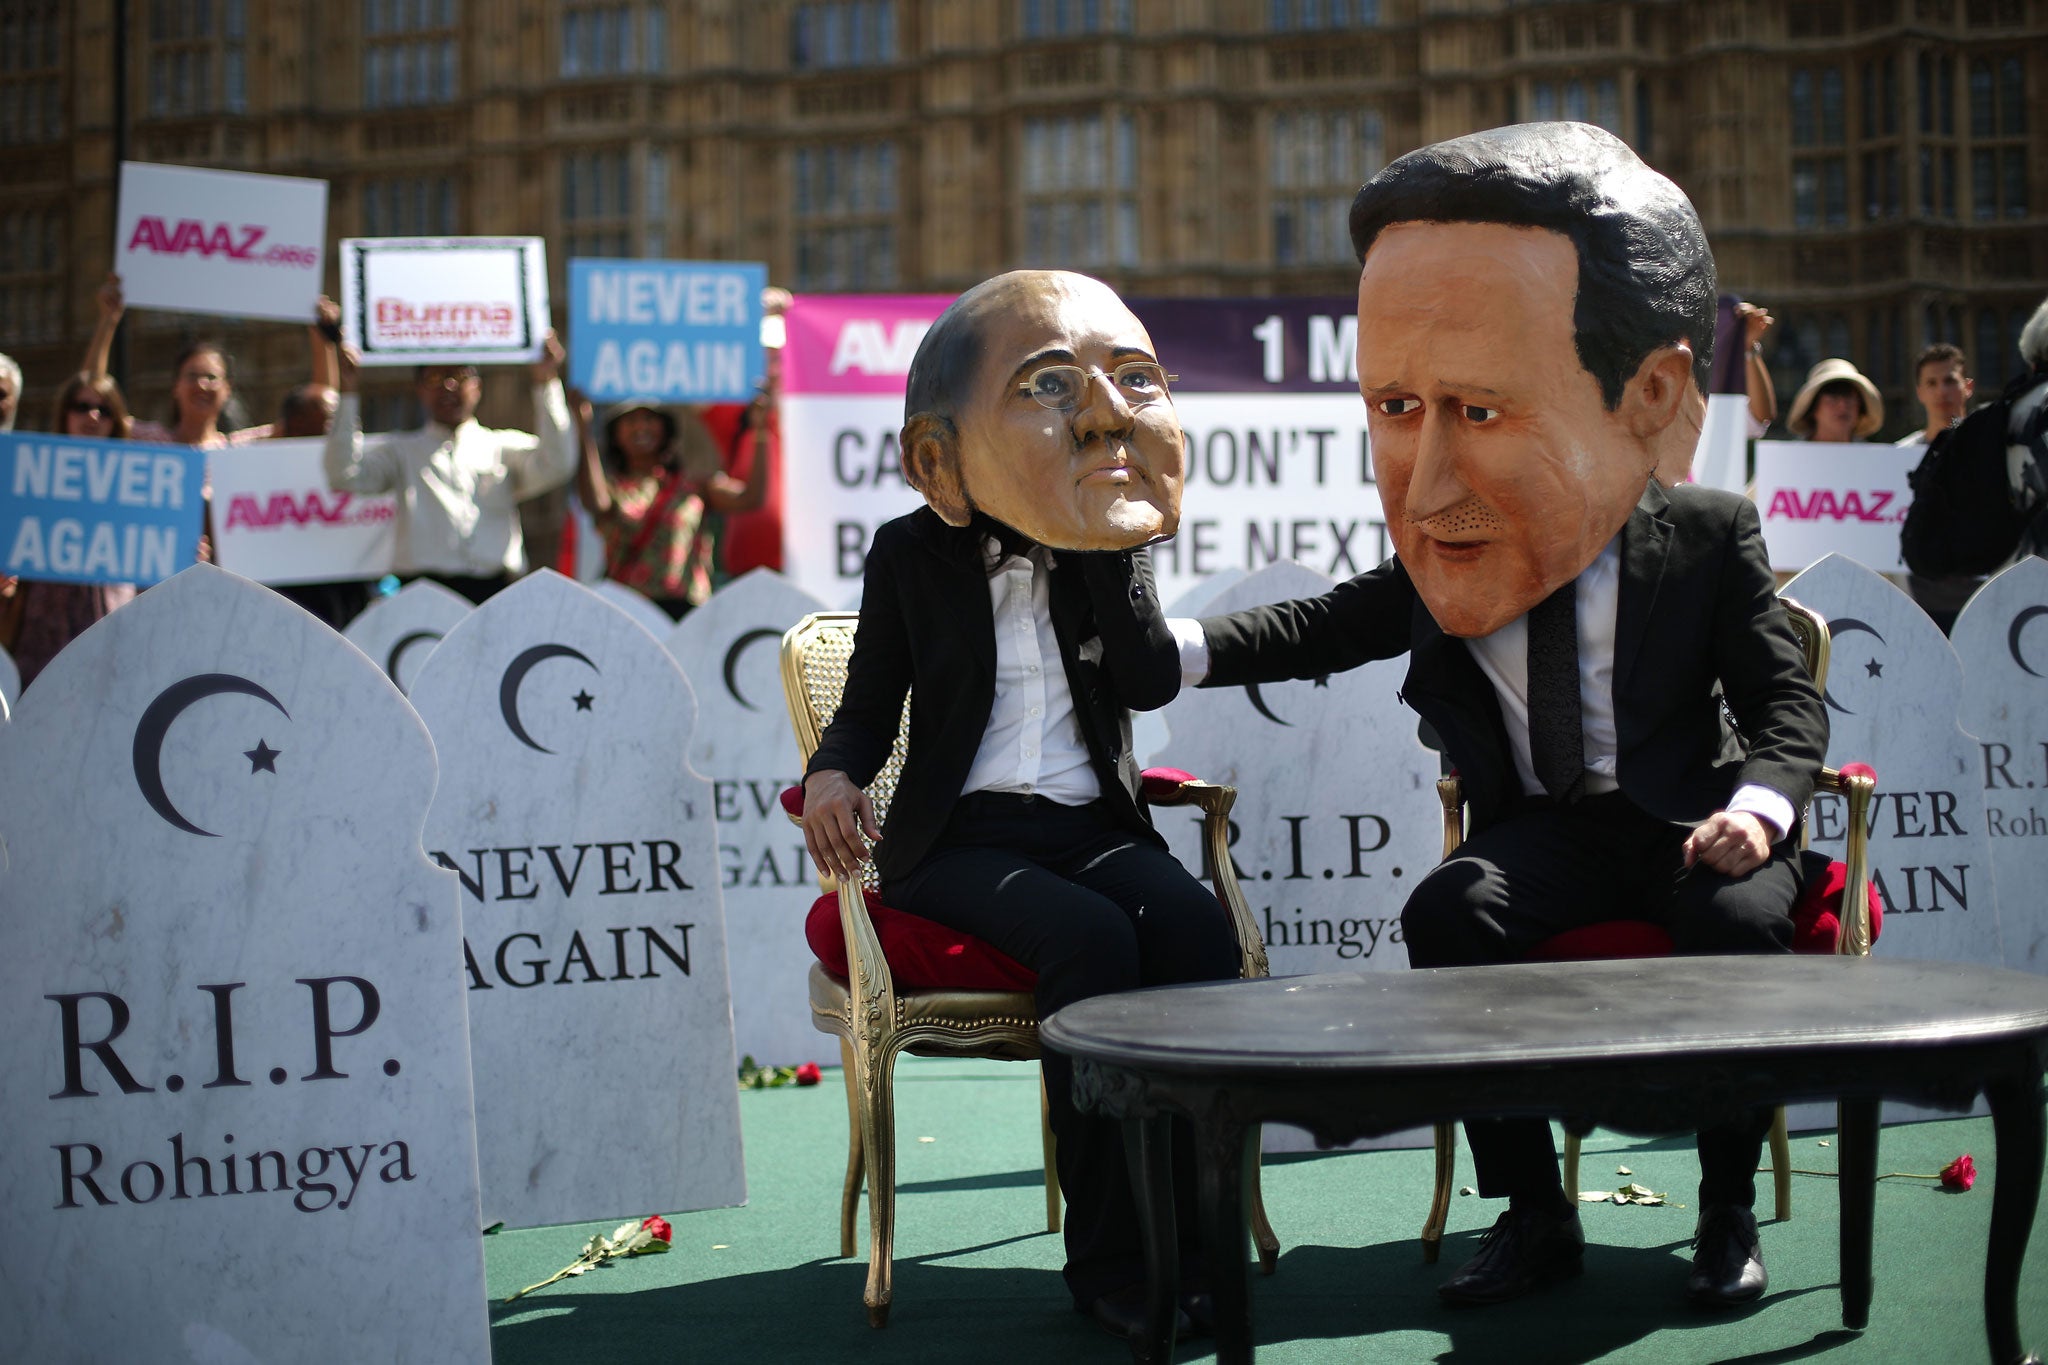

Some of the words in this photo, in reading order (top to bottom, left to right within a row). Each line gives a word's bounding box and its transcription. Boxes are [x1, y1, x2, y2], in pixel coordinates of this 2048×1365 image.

[376, 298, 513, 325] Burma
[588, 270, 747, 325] NEVER
[591, 341, 744, 395] AGAIN
[1253, 315, 1284, 383] 1
[13, 443, 185, 510] NEVER
[7, 515, 177, 578] AGAIN
[1248, 518, 1388, 576] NEXT
[429, 840, 694, 903] NEVER
[1190, 814, 1403, 881] R.I.P.
[43, 975, 401, 1100] R.I.P.
[50, 1132, 418, 1213] Rohingya
